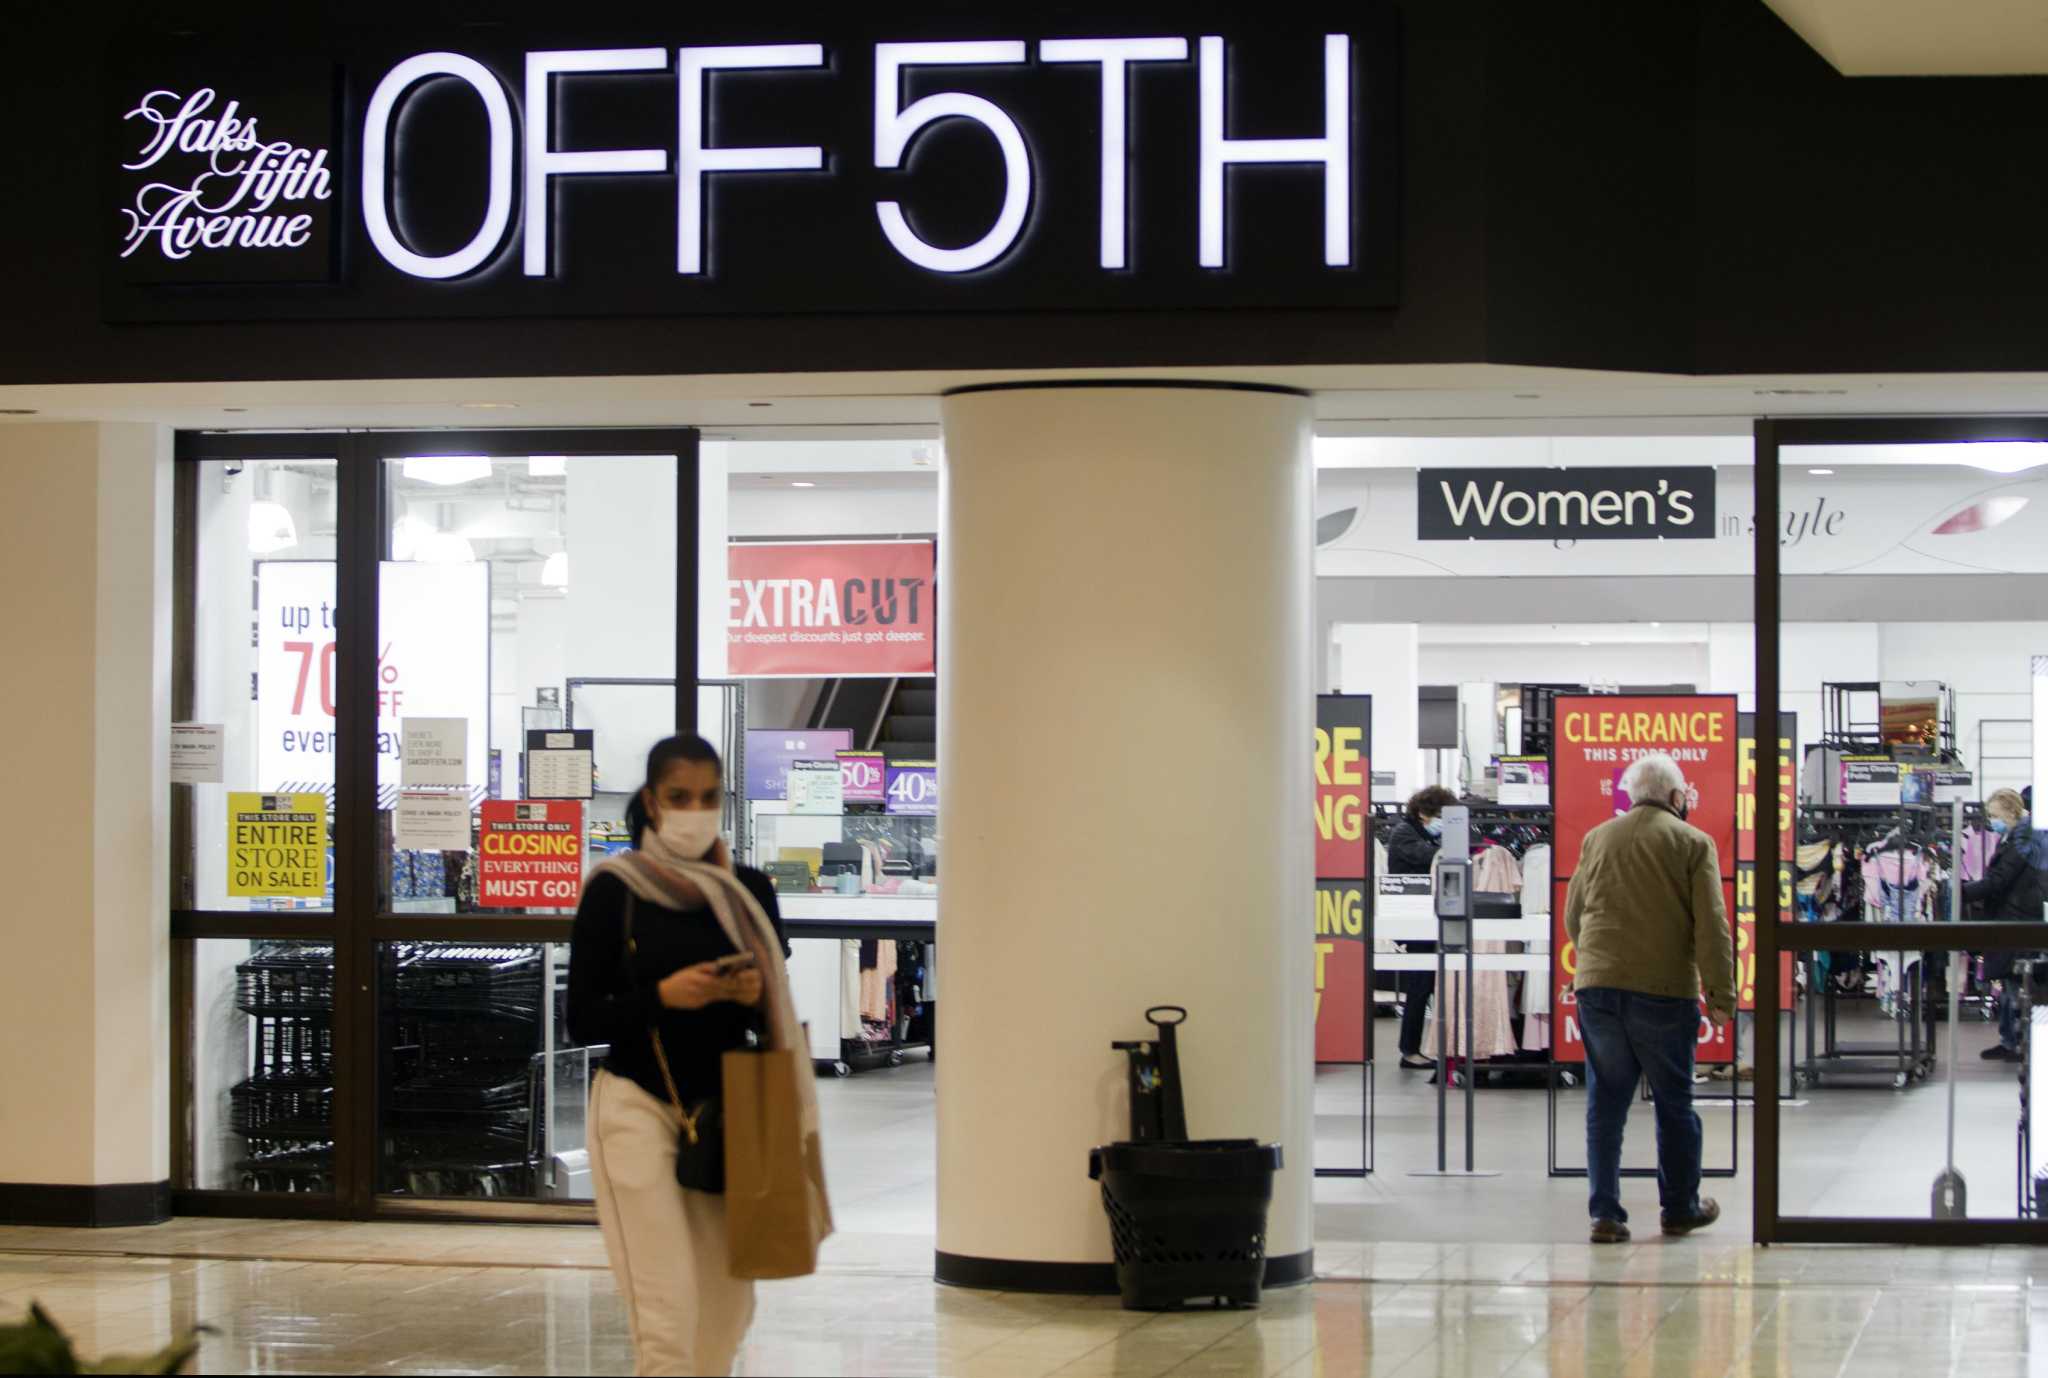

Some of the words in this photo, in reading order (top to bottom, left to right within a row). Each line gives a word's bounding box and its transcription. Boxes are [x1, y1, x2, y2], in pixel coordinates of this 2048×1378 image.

[121, 88, 258, 170] Saks
[362, 44, 823, 279] OFF
[875, 35, 1349, 272] 5TH
[191, 142, 332, 213] Fifth
[120, 183, 313, 259] Avenue
[1440, 479, 1695, 527] Women's
[728, 578, 841, 627] EXTRA
[844, 577, 925, 625] CUT
[282, 605, 310, 634] up
[790, 631, 841, 643] discounts
[1564, 712, 1724, 743] CLEARANCE
[1583, 748, 1617, 761] THIS
[1671, 747, 1709, 761] ONLY
[237, 825, 318, 845] ENTIRE
[491, 823, 513, 831] THIS
[515, 823, 545, 831] STORE
[546, 823, 571, 832] ONLY
[483, 833, 578, 856] CLOSING
[236, 848, 318, 869] STORE
[484, 861, 579, 874] EVERYTHING
[236, 871, 263, 887] ON
[268, 871, 318, 888] SALE!
[486, 879, 539, 897] MUST
[542, 880, 577, 898] GO!
